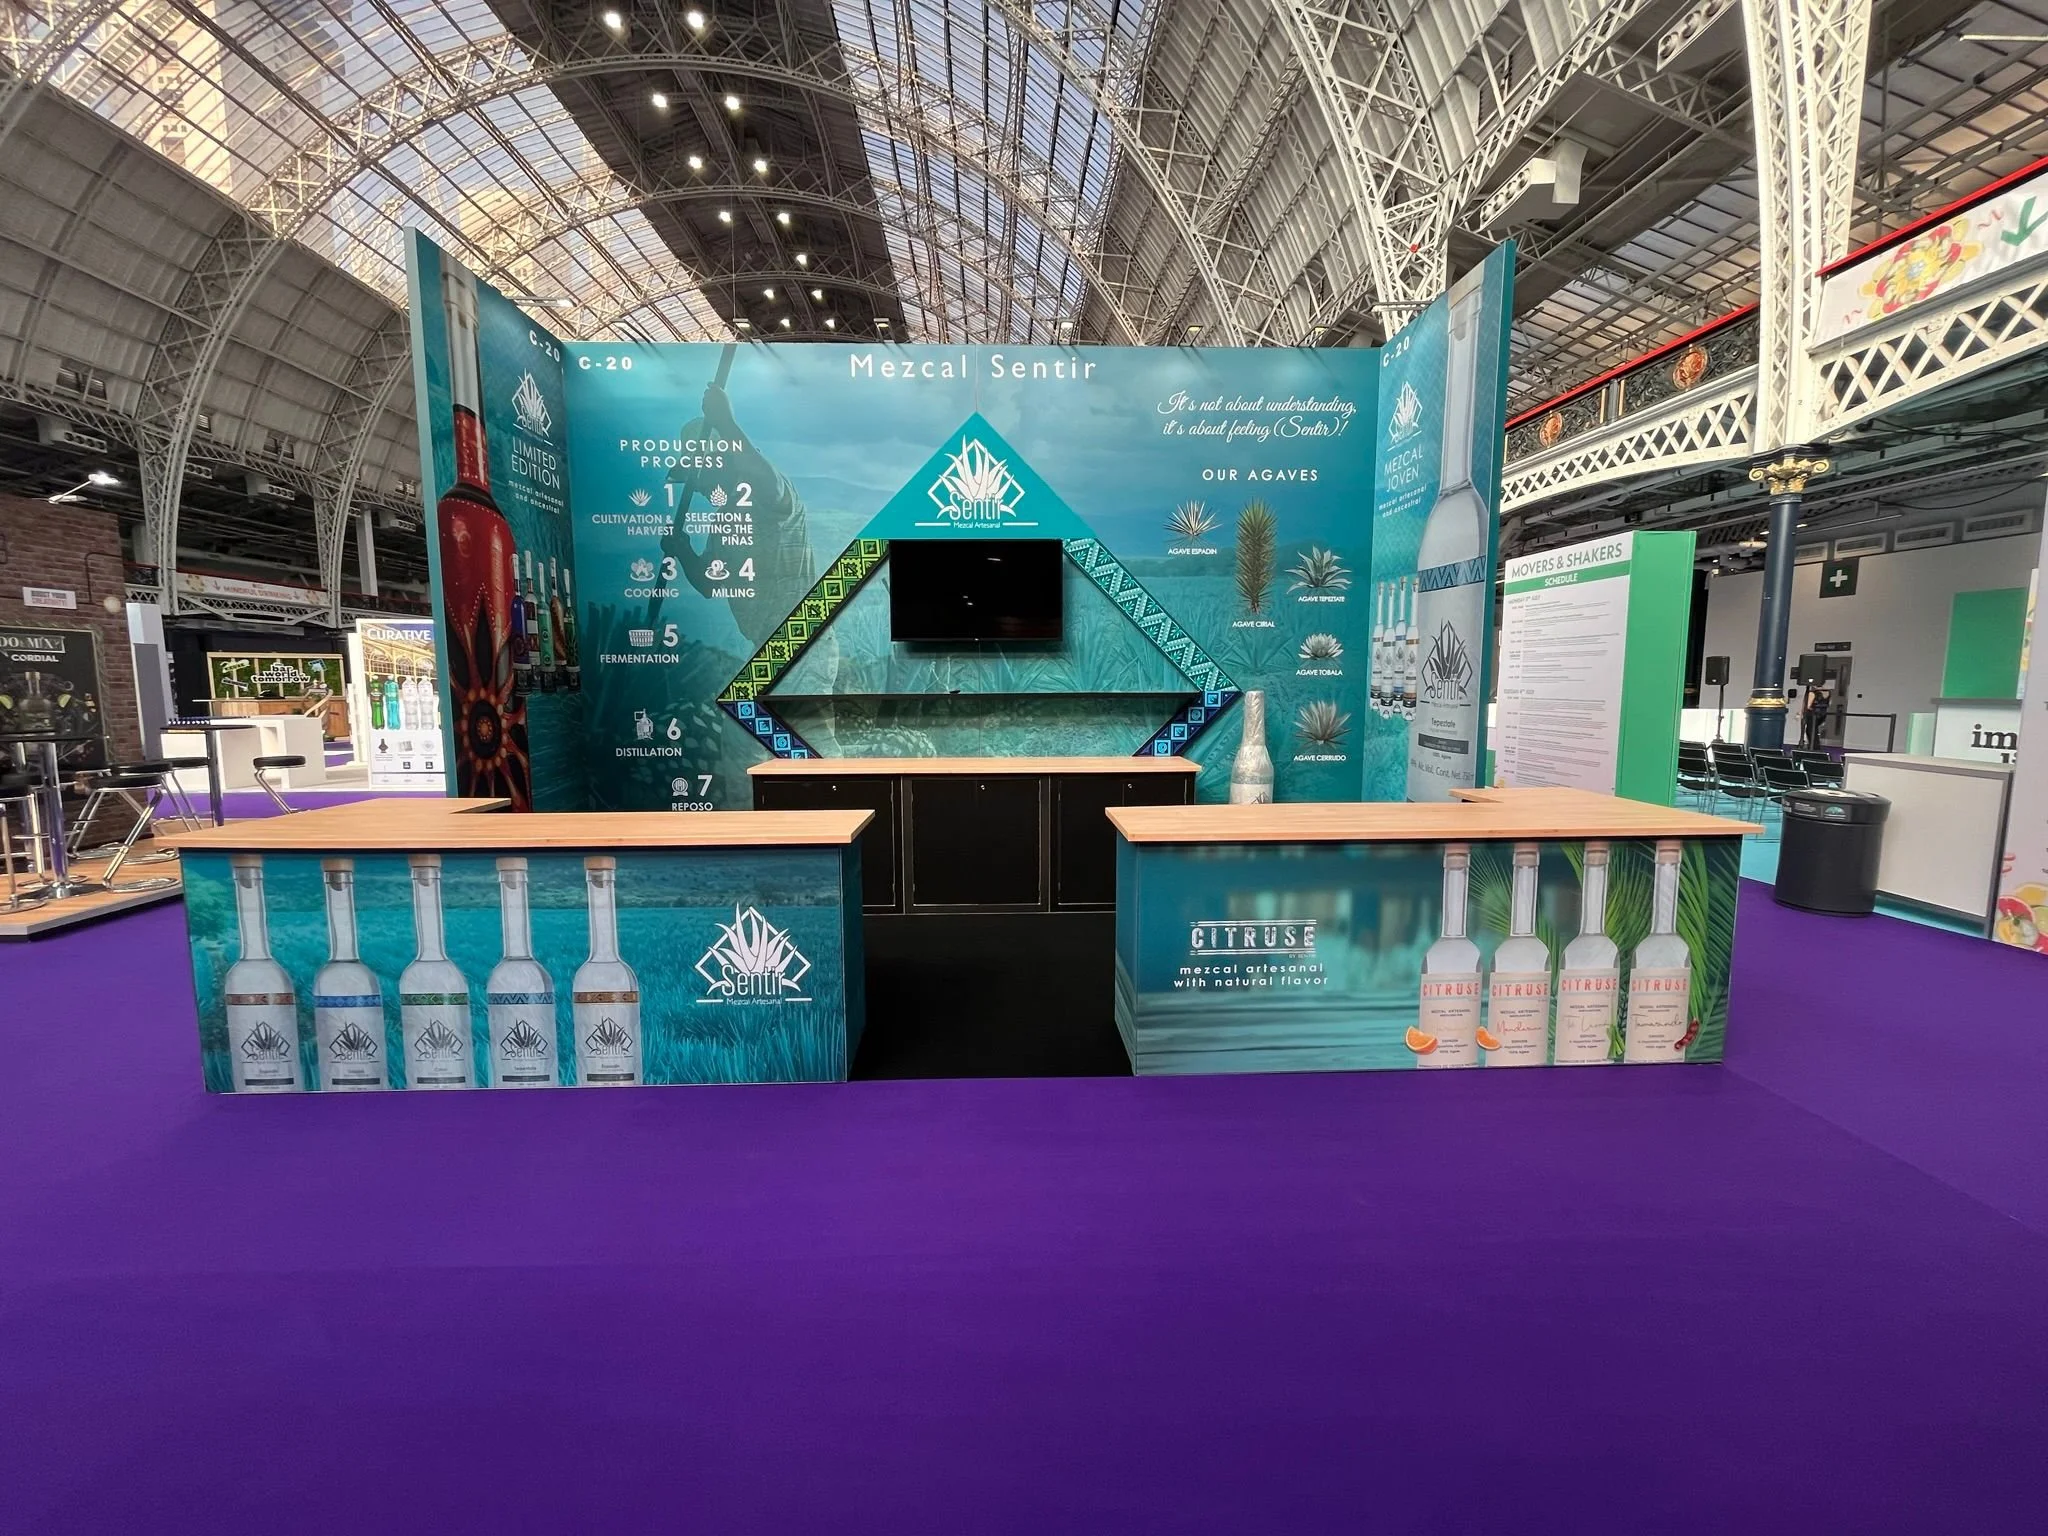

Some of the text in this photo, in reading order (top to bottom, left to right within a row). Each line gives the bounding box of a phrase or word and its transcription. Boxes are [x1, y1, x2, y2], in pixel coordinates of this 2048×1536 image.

[529, 330, 560, 362] C-20
[1383, 336, 1410, 367] C-20
[578, 356, 633, 371] C-20
[850, 354, 1096, 379] Mezcal Sentir
[1199, 395, 1223, 412] not
[1225, 395, 1264, 412] about
[1266, 395, 1357, 419] understanding,
[1189, 420, 1226, 436] about
[1226, 419, 1271, 443] feeling
[1273, 415, 1349, 438] (Sentir)!
[619, 439, 743, 451] PRODUCTION
[512, 437, 557, 470] LIMITED
[1384, 444, 1423, 477] MEZCAL
[640, 456, 724, 468] PROCESS
[511, 454, 561, 490] EDITION
[1202, 469, 1318, 482] OUR AGAVES
[1387, 464, 1419, 493] JOVEN
[508, 479, 533, 495] mezcal
[663, 483, 674, 507] 1
[736, 482, 753, 507] 2
[515, 493, 560, 515] and ancestral
[949, 490, 1004, 521] Sentir
[1379, 496, 1398, 511] mezcal
[591, 514, 674, 524] CULTIVATION &
[685, 512, 753, 522] SELECTION &
[1382, 507, 1393, 518] and
[627, 526, 674, 536] HARVEST
[685, 524, 753, 534] CUTTING THE
[721, 534, 754, 546] PIÑAS
[1511, 543, 1623, 578] MOVERS & SHAKERS
[661, 556, 677, 581] 3
[738, 557, 756, 582] 4
[1544, 573, 1578, 587] SCHEDULE
[624, 588, 680, 598] COOKING
[711, 588, 756, 598] MILLING
[366, 628, 432, 641] CURATIVE
[662, 624, 679, 647] 5
[11, 654, 59, 662] CORDIAL
[600, 654, 679, 664] FERMENTATION
[264, 670, 297, 678] world
[272, 665, 292, 673] bar
[1429, 671, 1461, 700] Sentir
[666, 717, 681, 740] 6
[615, 747, 682, 757] DISTILLATION
[697, 774, 713, 797] 7
[671, 802, 714, 812] REPOSO
[1191, 926, 1316, 949] CITRUSE
[1180, 963, 1323, 975] mezcal artesanal
[721, 963, 785, 996] Sentir
[1174, 976, 1328, 987] with natural flavor
[1561, 979, 1617, 991] CITRUSE
[1632, 979, 1687, 992] CITRUSE
[1423, 983, 1479, 997] CITRUSE
[1492, 983, 1548, 997] CITRUSE
[726, 997, 782, 1005] Mezcal Artesanal
